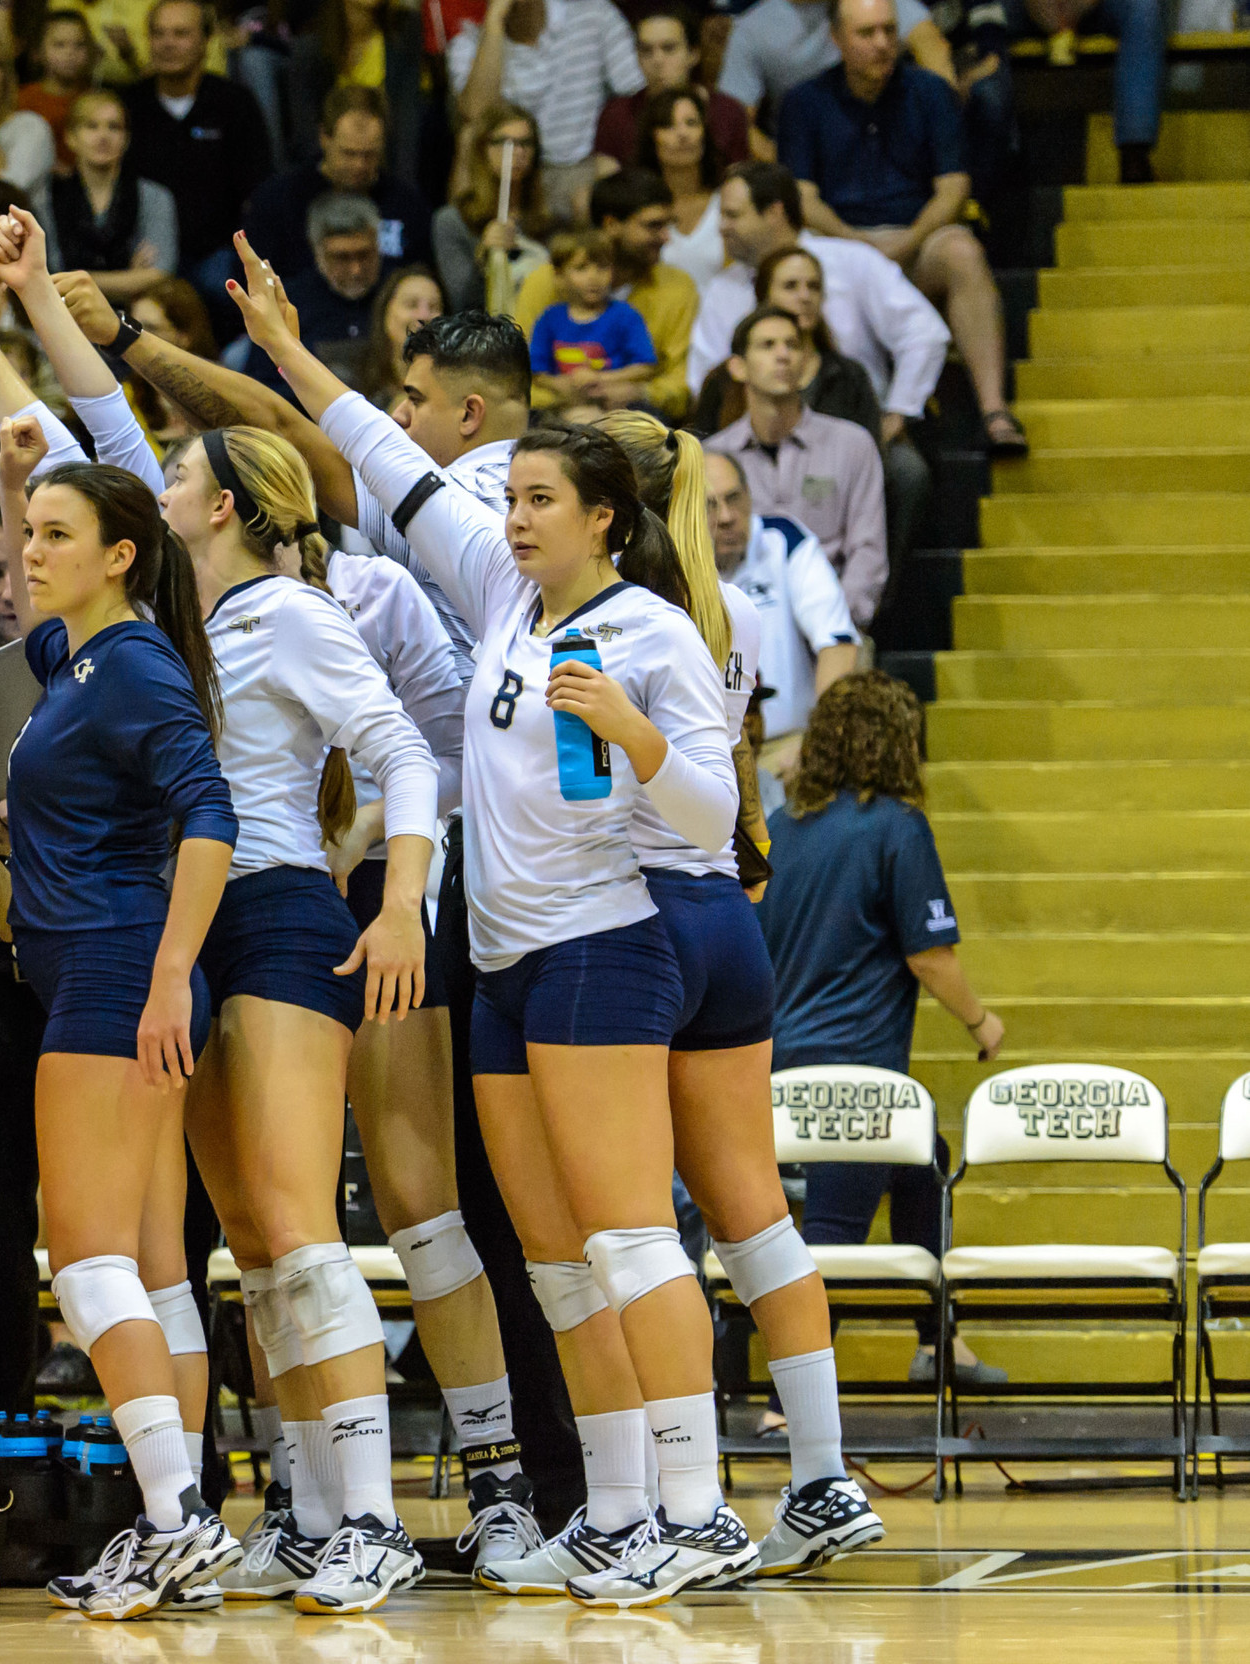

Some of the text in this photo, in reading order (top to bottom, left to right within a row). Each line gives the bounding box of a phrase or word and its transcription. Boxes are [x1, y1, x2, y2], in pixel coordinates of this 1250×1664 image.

[489, 668, 524, 732] 8
[989, 1078, 1151, 1107] GEORGIA
[790, 1110, 892, 1140] TECH
[1018, 1108, 1121, 1139] TECH
